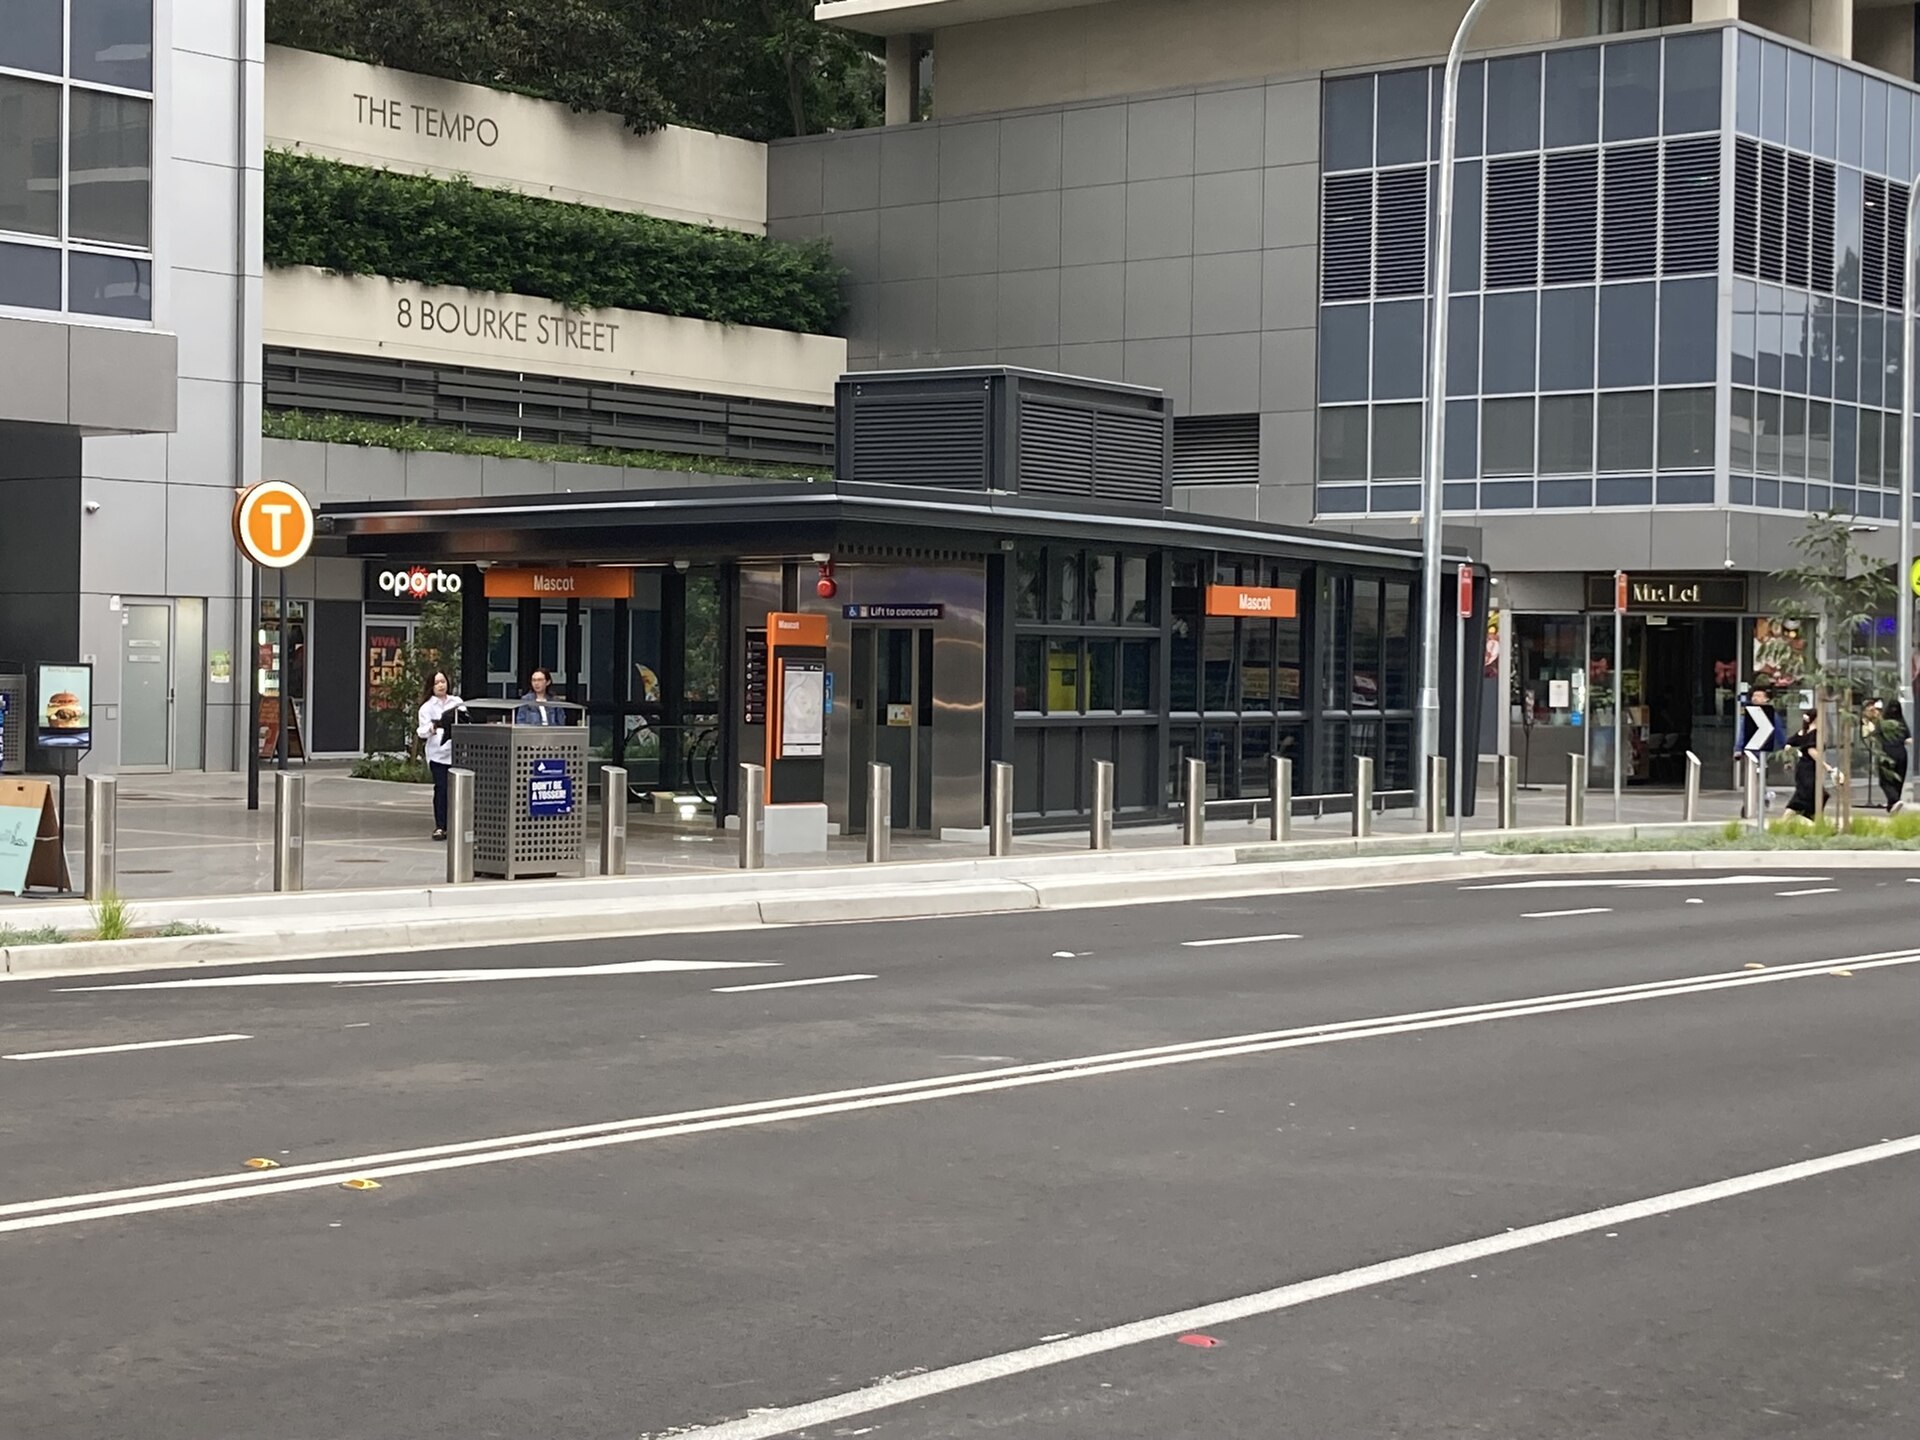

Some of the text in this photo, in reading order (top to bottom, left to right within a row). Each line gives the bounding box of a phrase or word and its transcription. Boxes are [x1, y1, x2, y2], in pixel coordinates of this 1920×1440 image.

[353, 93, 499, 147] THE TEMPO
[397, 298, 620, 353] 8 BOURKE STREET
[261, 504, 293, 551] T
[379, 568, 462, 597] oporto
[533, 575, 575, 591] Mascot
[870, 607, 938, 617] Lift to concourse
[1239, 593, 1272, 611] Mascot
[531, 791, 538, 800] A
